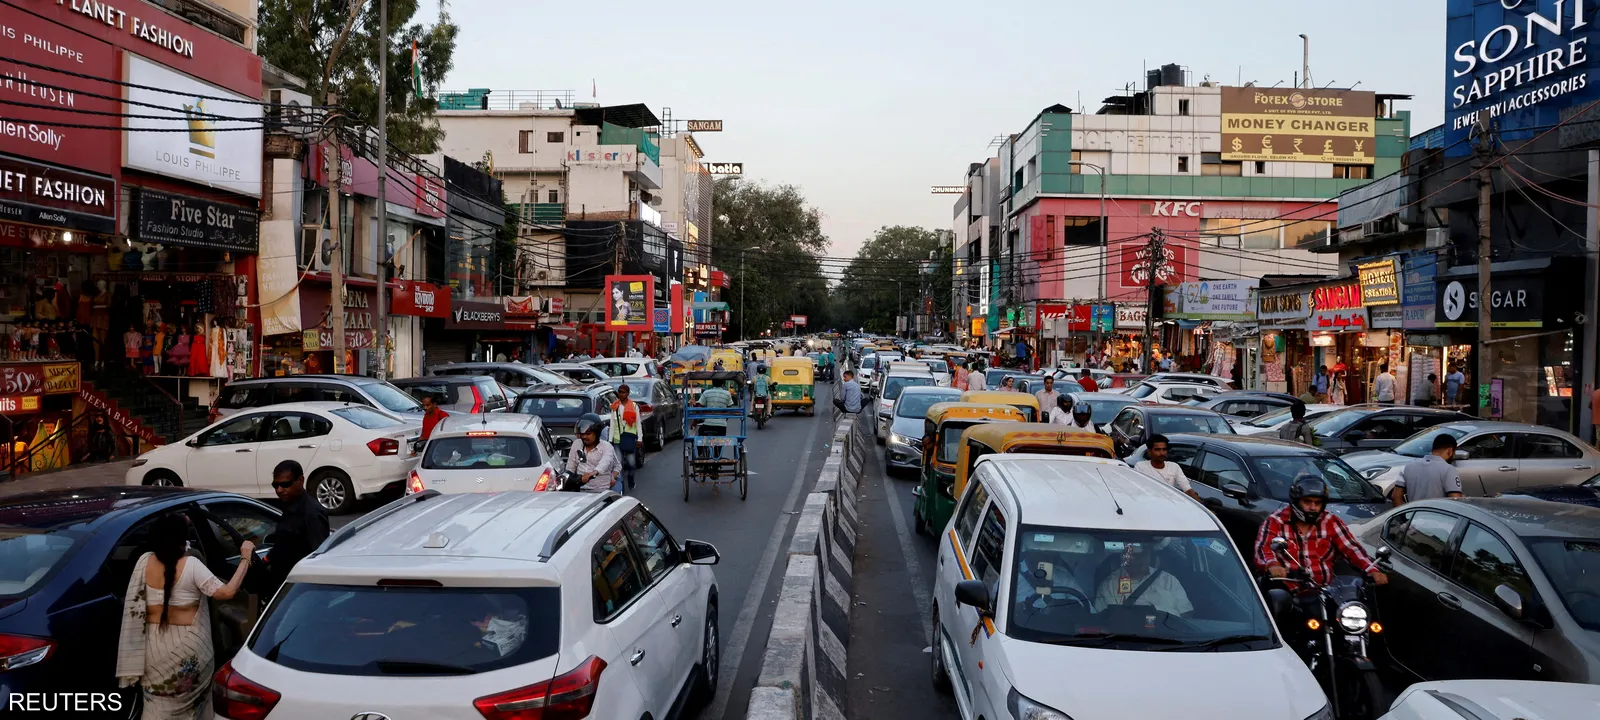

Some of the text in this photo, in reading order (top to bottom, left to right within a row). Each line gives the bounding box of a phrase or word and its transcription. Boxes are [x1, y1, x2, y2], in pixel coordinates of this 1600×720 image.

[0, 25, 84, 64] IS PHILIPPE
[131, 17, 194, 58] FASHION
[1453, 0, 1588, 78] SONI
[1453, 37, 1587, 109] SAPPHIRE
[1307, 97, 1343, 107] STORE
[1453, 73, 1587, 131] JEWELRY ACCESSORIES
[688, 122, 722, 130] SANGAM
[1227, 118, 1369, 132] MONEY CHANGER
[29, 124, 62, 151] Solly
[156, 150, 241, 181] LOUIS PHILIPPE
[709, 163, 741, 174] batla
[0, 169, 105, 208] ET FASHION
[39, 211, 67, 225] Allen Solly
[170, 199, 235, 229] Five Star
[1151, 201, 1200, 218] KFC
[19, 227, 48, 241] STAR
[146, 220, 179, 235] Fashion
[180, 226, 204, 239] Studio
[1222, 283, 1237, 291] EARTH
[1222, 293, 1238, 301] FAMILY
[1314, 284, 1362, 311] SANGAM
[1468, 289, 1527, 308] SGAR
[326, 311, 372, 329] BZAAR
[463, 311, 500, 322] BLACKBERRYS
[1119, 311, 1148, 322] BAGS
[5, 371, 41, 393] 50%
[80, 389, 112, 416] MEENA
